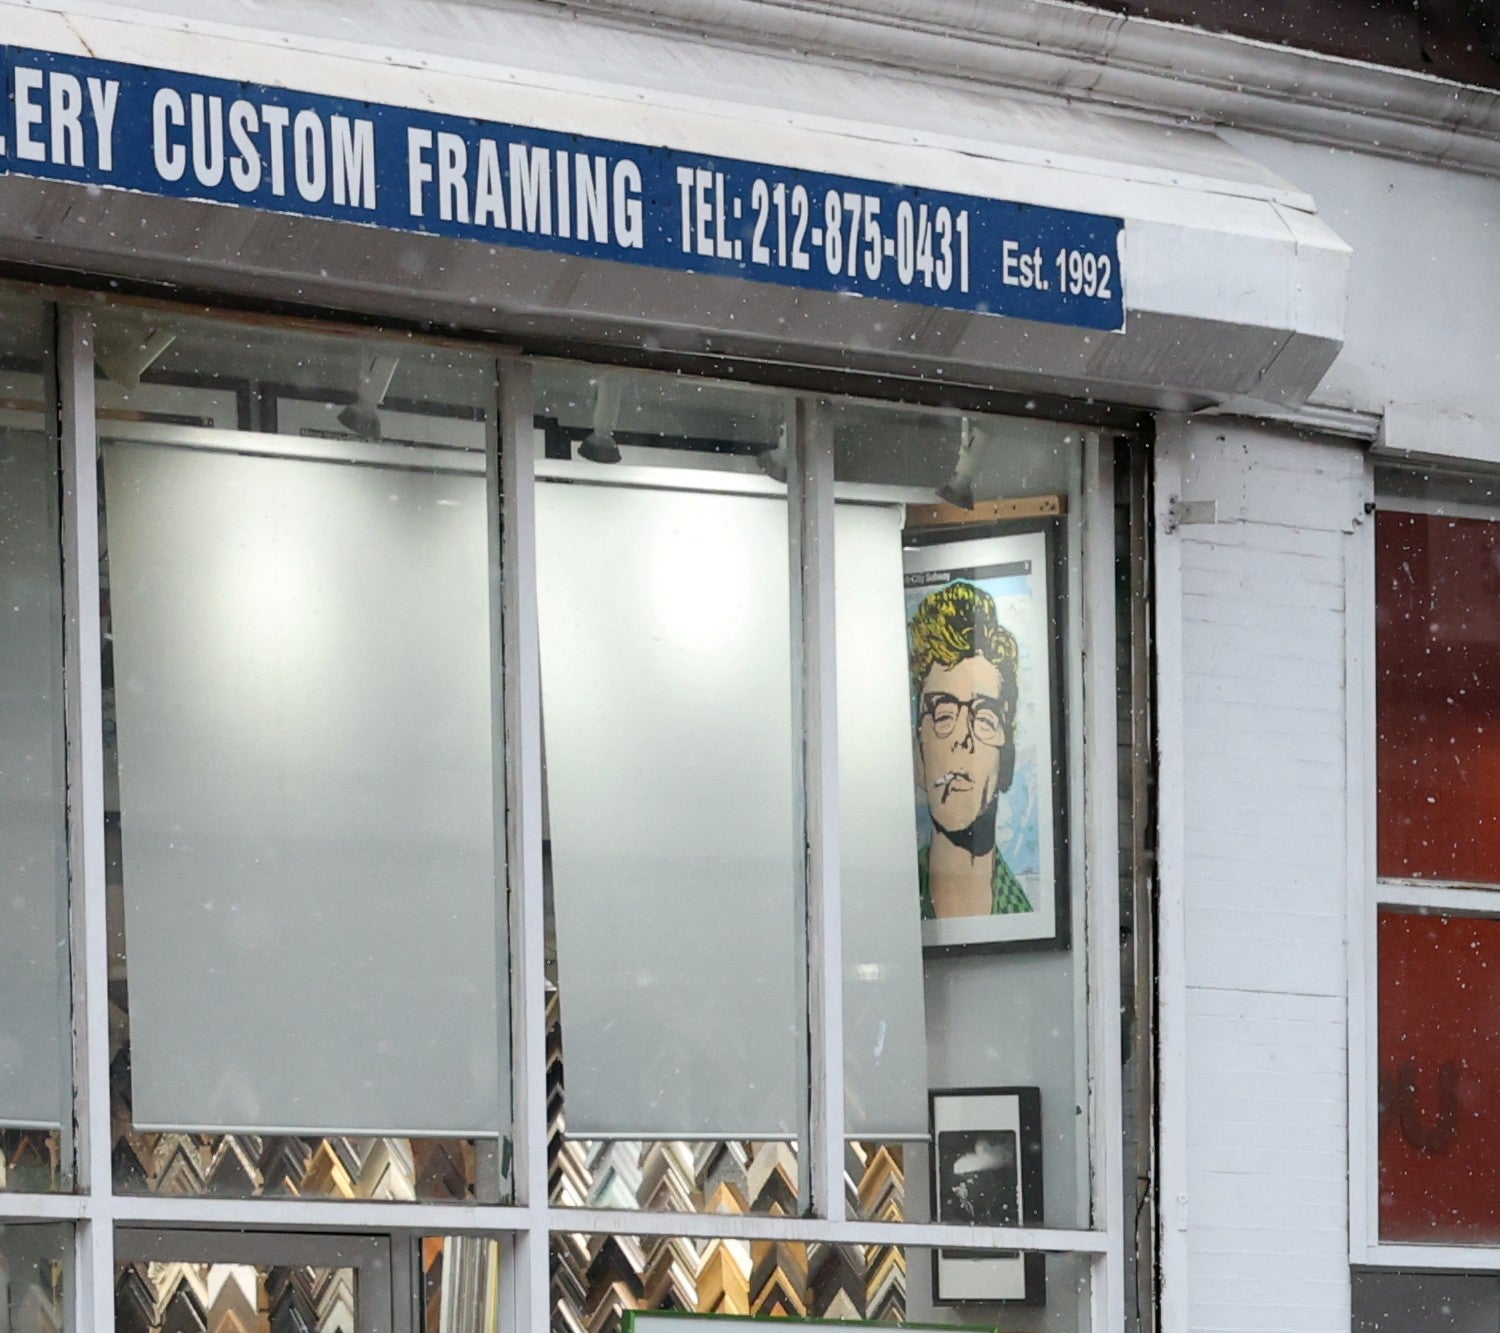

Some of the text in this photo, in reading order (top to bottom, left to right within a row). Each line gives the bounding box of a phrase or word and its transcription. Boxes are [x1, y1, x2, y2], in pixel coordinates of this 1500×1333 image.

[0, 66, 120, 172] ERY
[152, 87, 377, 211] CUSTOM
[407, 126, 644, 249] FRAMING
[1002, 239, 1049, 291] Est.
[1055, 247, 1112, 300] 1992
